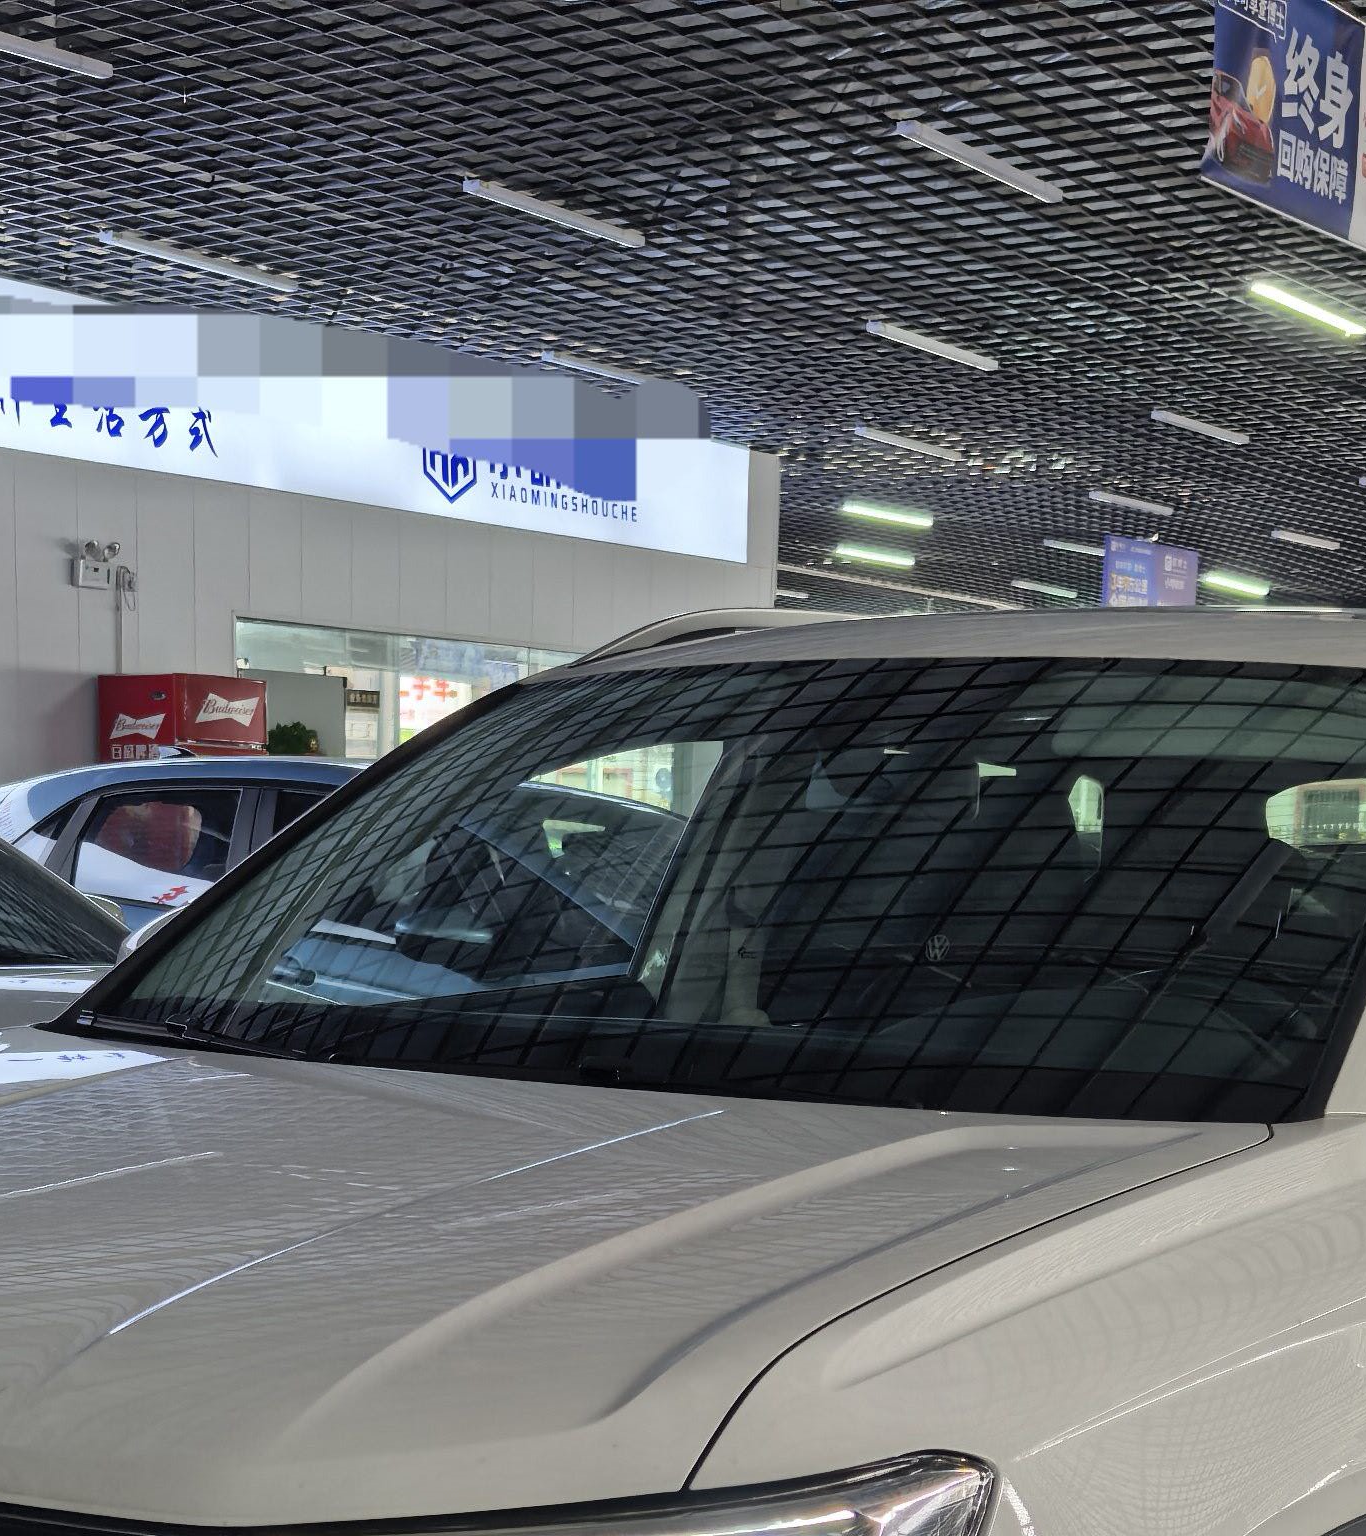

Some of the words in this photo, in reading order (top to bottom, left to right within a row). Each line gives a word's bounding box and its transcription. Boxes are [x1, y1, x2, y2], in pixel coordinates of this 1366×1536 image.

[1281, 27, 1354, 148] 终身
[1276, 129, 1348, 204] 回购保障
[491, 481, 638, 523] XIAOMINGSHOUCHE
[116, 717, 160, 732] Budweiser
[202, 700, 254, 716] Budweiser
